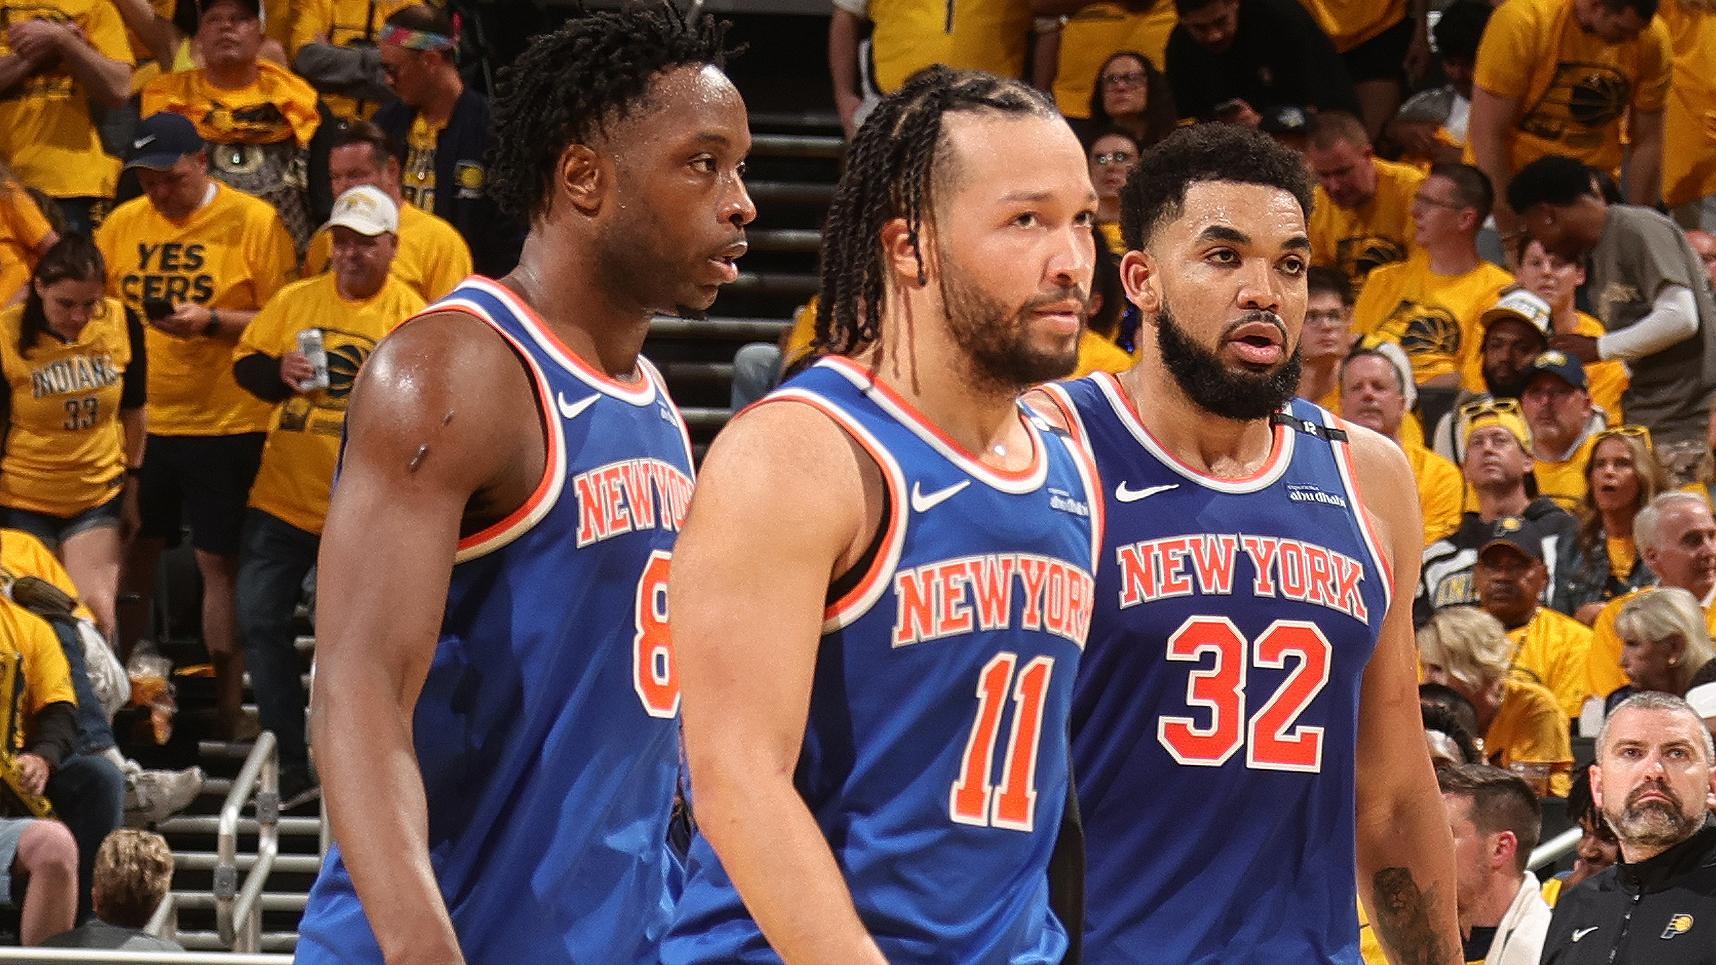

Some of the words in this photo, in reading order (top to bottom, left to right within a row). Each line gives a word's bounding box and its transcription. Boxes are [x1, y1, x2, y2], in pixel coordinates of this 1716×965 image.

[122, 275, 214, 303] CERS
[137, 242, 205, 271] YES
[64, 397, 98, 431] 33
[1303, 420, 1318, 435] 12
[573, 457, 654, 549] NEW
[1290, 490, 1315, 502] abu
[1315, 491, 1347, 508] dhabi
[892, 552, 1017, 649] NEW
[1116, 533, 1240, 610] NEW
[1241, 533, 1369, 625] YORK
[633, 549, 682, 719] 8
[1157, 615, 1333, 774] 32
[949, 650, 1055, 832] 11
